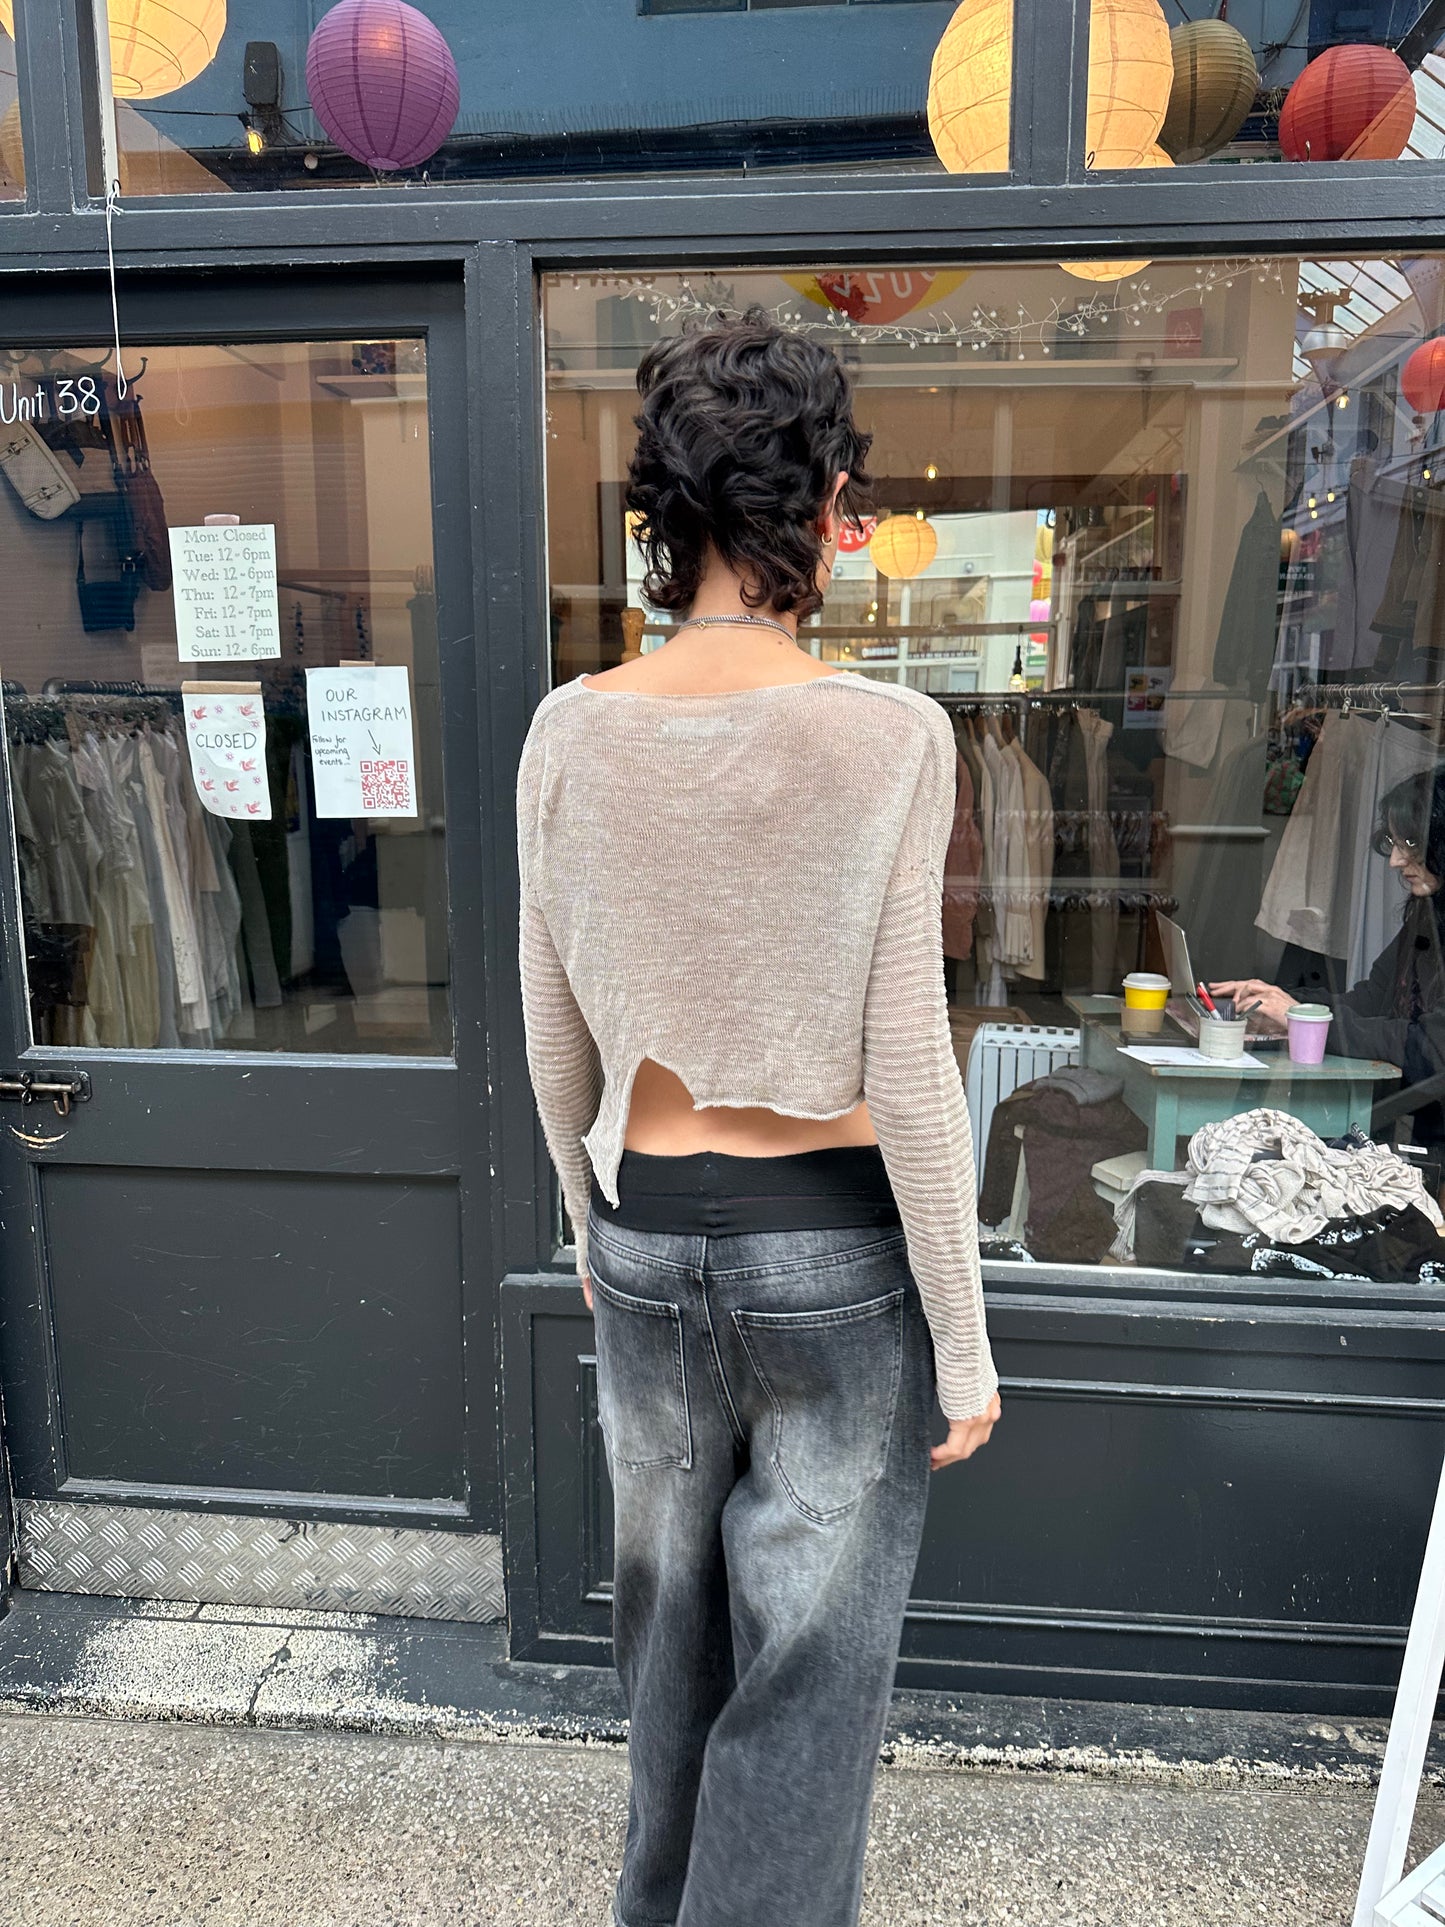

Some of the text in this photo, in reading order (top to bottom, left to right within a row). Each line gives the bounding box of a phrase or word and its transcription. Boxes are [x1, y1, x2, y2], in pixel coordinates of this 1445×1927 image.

[0, 376, 100, 425] Unit 38
[184, 528, 267, 543] Mon: Closed
[183, 550, 214, 562] Tue:
[182, 569, 219, 582] Wed:
[181, 588, 214, 601] Thu:
[194, 607, 217, 619] Fri:
[196, 626, 220, 638] Sat:
[191, 644, 221, 657] Sun:
[326, 688, 358, 702] OUR
[321, 706, 408, 722] INSTAGRAM
[195, 732, 257, 750] CLOSED
[312, 734, 347, 749] Follow for
[314, 747, 351, 760] upcoming
